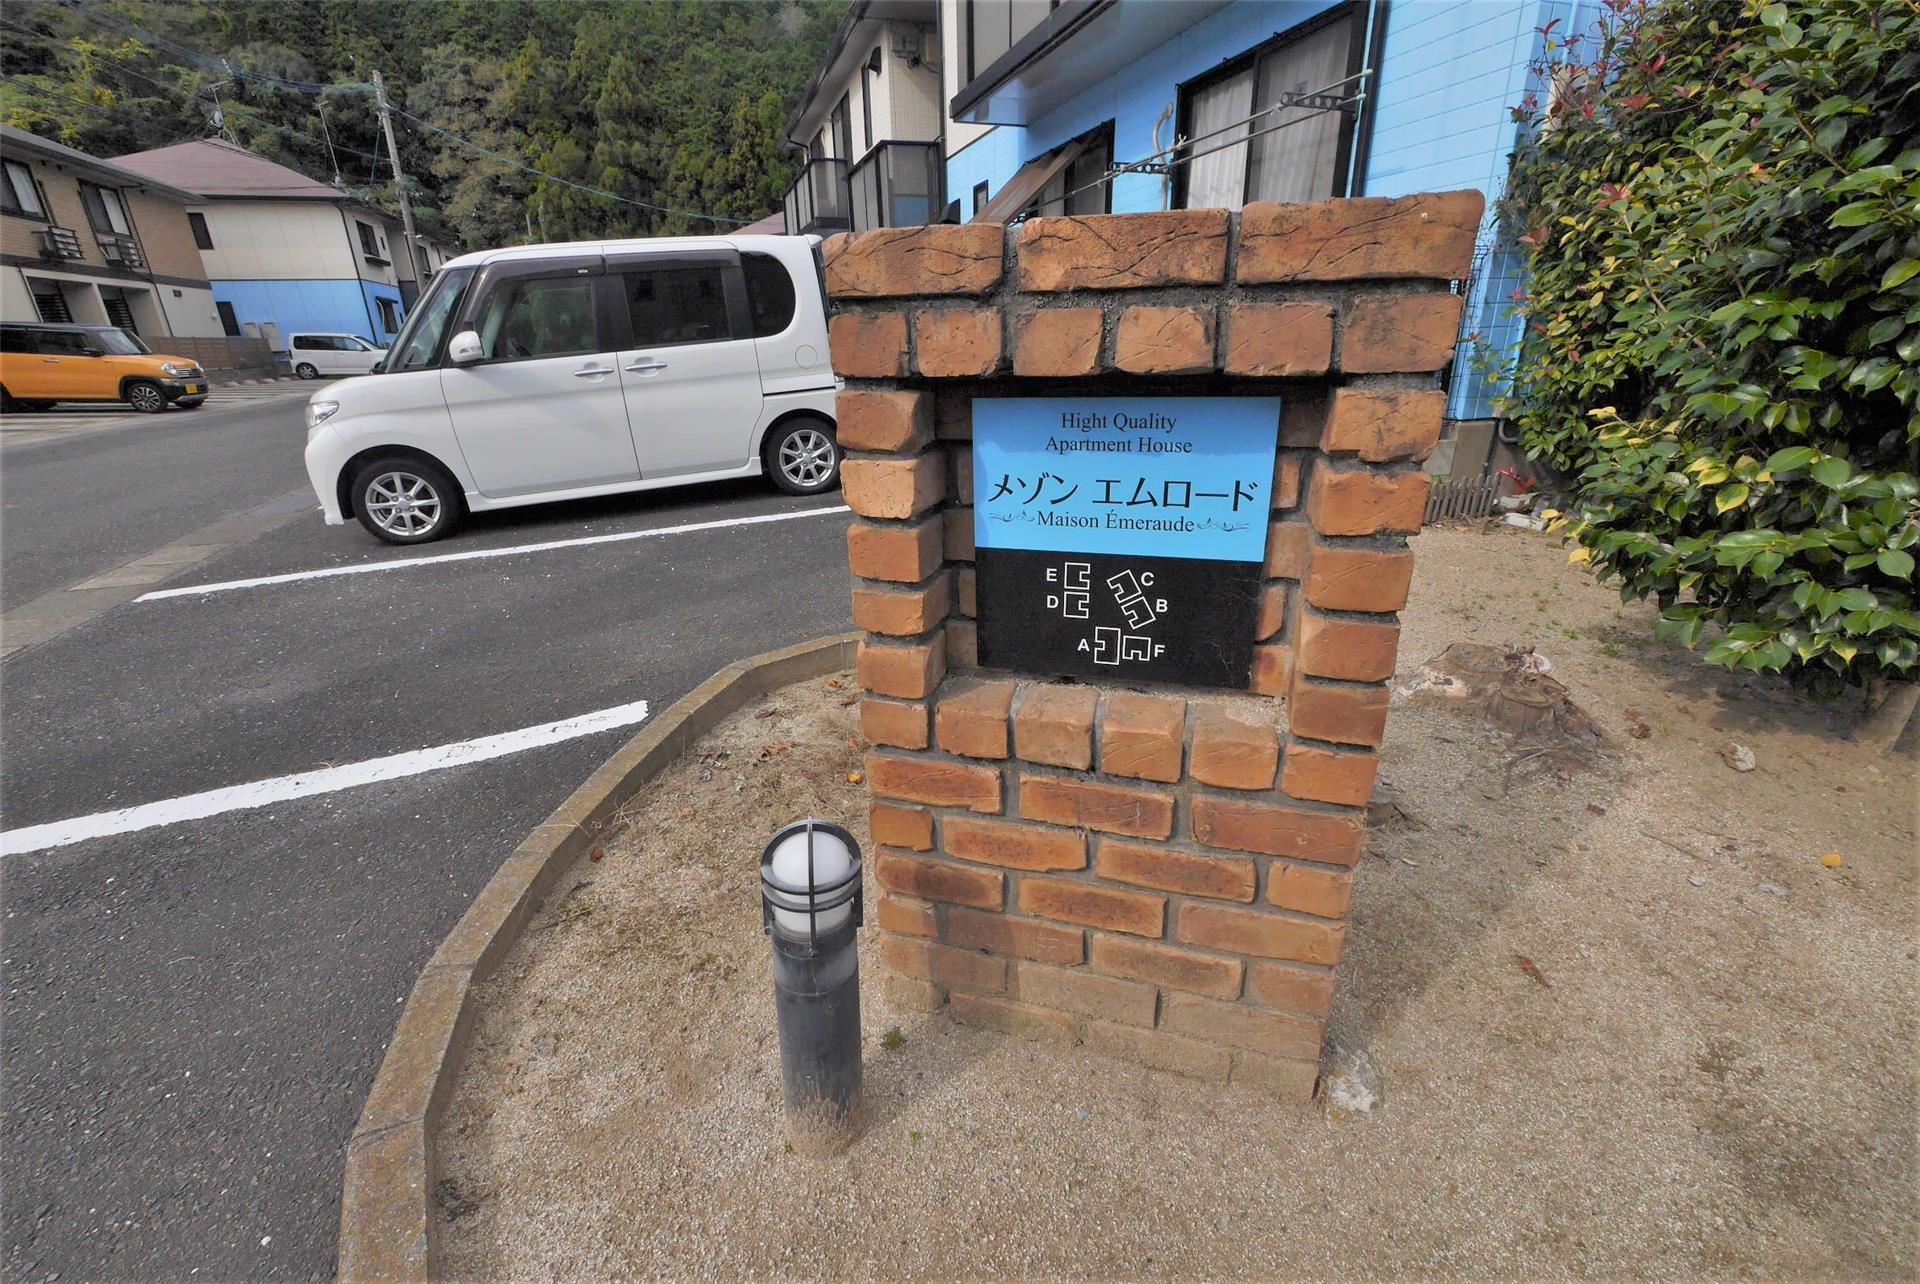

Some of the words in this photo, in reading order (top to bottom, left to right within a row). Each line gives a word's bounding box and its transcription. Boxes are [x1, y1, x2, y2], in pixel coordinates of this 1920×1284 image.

[1061, 412, 1107, 433] Hight
[1113, 412, 1177, 434] Quality
[1045, 436, 1132, 455] Apartment
[1138, 437, 1193, 454] House
[988, 472, 1079, 506] メゾン
[1092, 477, 1259, 512] エムロード
[1037, 511, 1099, 529] Maison
[1106, 509, 1195, 533] Émeraude
[1046, 568, 1057, 581] E
[1140, 572, 1154, 586] C
[1046, 595, 1059, 608] D
[1155, 599, 1168, 612] B
[1077, 638, 1090, 651] A
[1154, 645, 1165, 657] F
